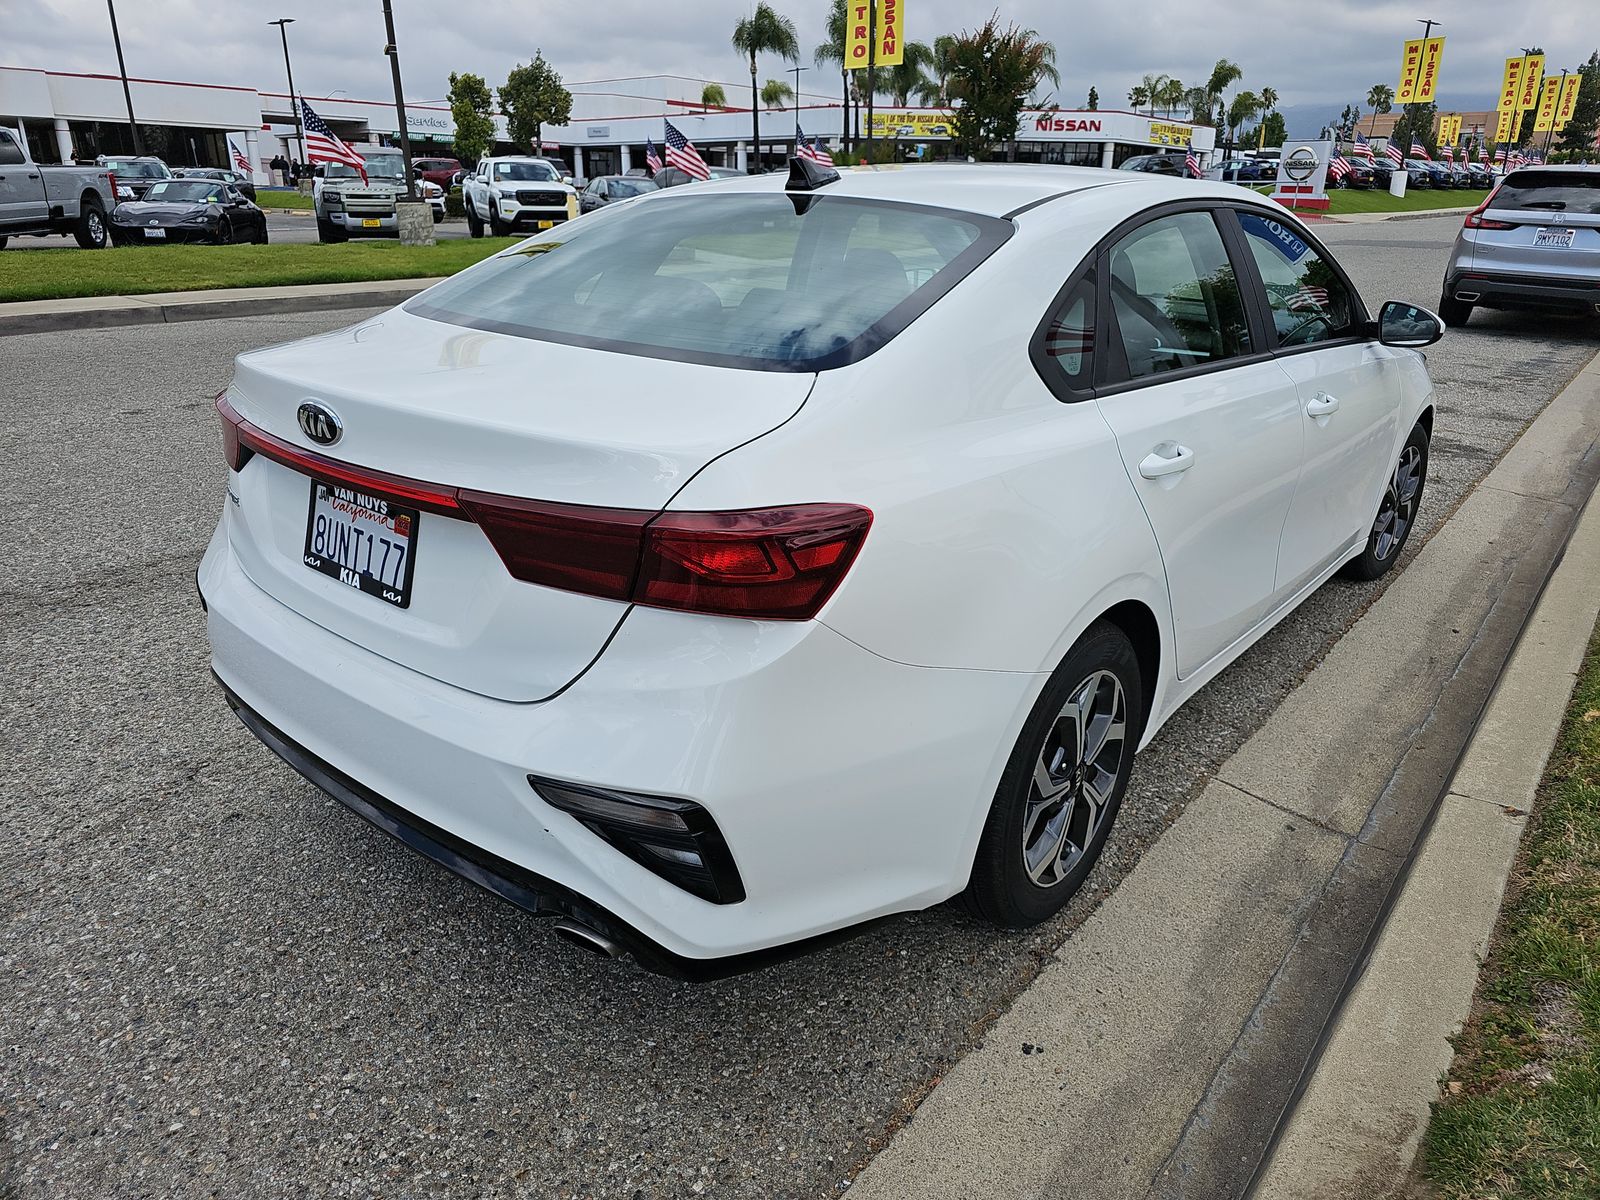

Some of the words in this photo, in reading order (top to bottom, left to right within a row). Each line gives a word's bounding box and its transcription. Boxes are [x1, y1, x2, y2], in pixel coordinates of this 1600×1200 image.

[853, 0, 867, 58] TRO
[1400, 45, 1419, 98] METRO
[1420, 43, 1439, 97] NISSAN
[1503, 61, 1520, 107] METRO
[1522, 60, 1540, 106] NISSAN
[1542, 80, 1558, 118] METRO
[1560, 78, 1577, 117] NISSAN
[406, 115, 448, 128] Service
[1035, 118, 1102, 132] NISSAN
[1439, 119, 1449, 144] METRO
[1497, 111, 1509, 140] METRO
[299, 409, 332, 439] KIA
[332, 497, 394, 531] California
[334, 486, 354, 503] VAN
[357, 492, 388, 515] NUYS
[314, 513, 405, 588] 8UNT177
[339, 567, 361, 589] KIA
